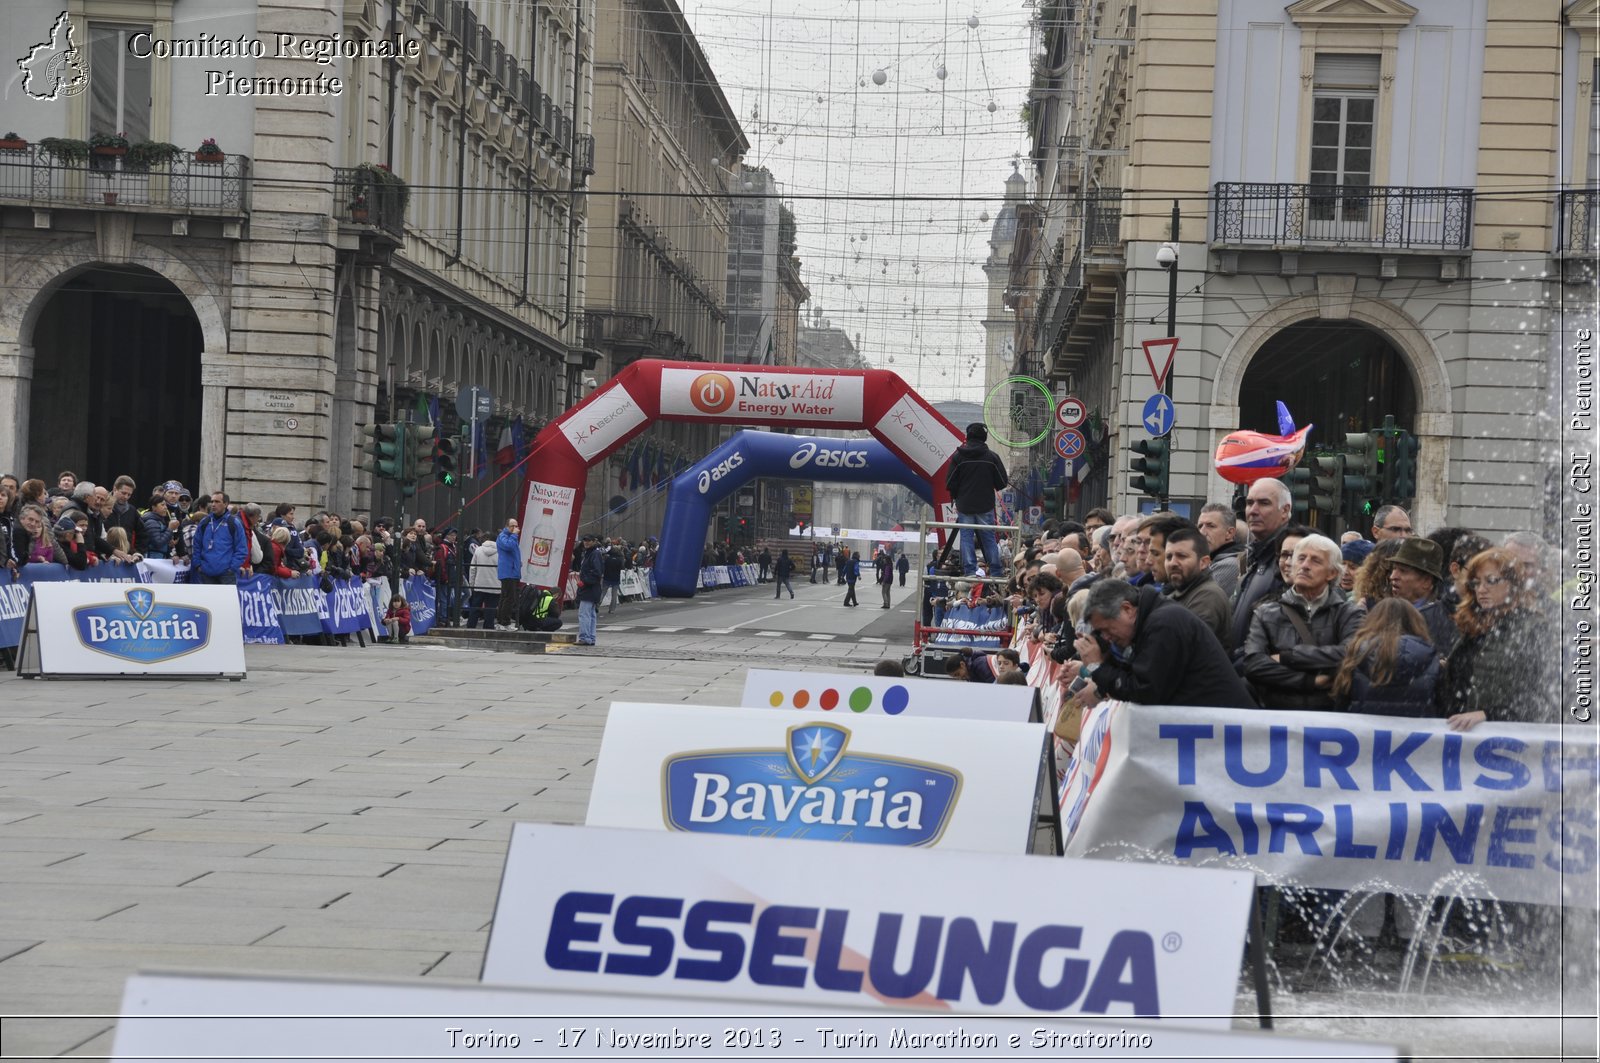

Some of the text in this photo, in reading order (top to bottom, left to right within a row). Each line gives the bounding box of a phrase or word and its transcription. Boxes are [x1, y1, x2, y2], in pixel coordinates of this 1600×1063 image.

[589, 401, 632, 434] ABEKOM
[738, 401, 835, 415] Energy Water
[904, 422, 944, 459] ABEKOM
[531, 495, 570, 507] Energy Water
[87, 614, 200, 643] Bavaria
[1159, 724, 1600, 793] TURKISH
[689, 773, 923, 830] Bavaria
[1173, 801, 1598, 875] AIRLINES
[544, 891, 1161, 1018] ESSELUNGA
